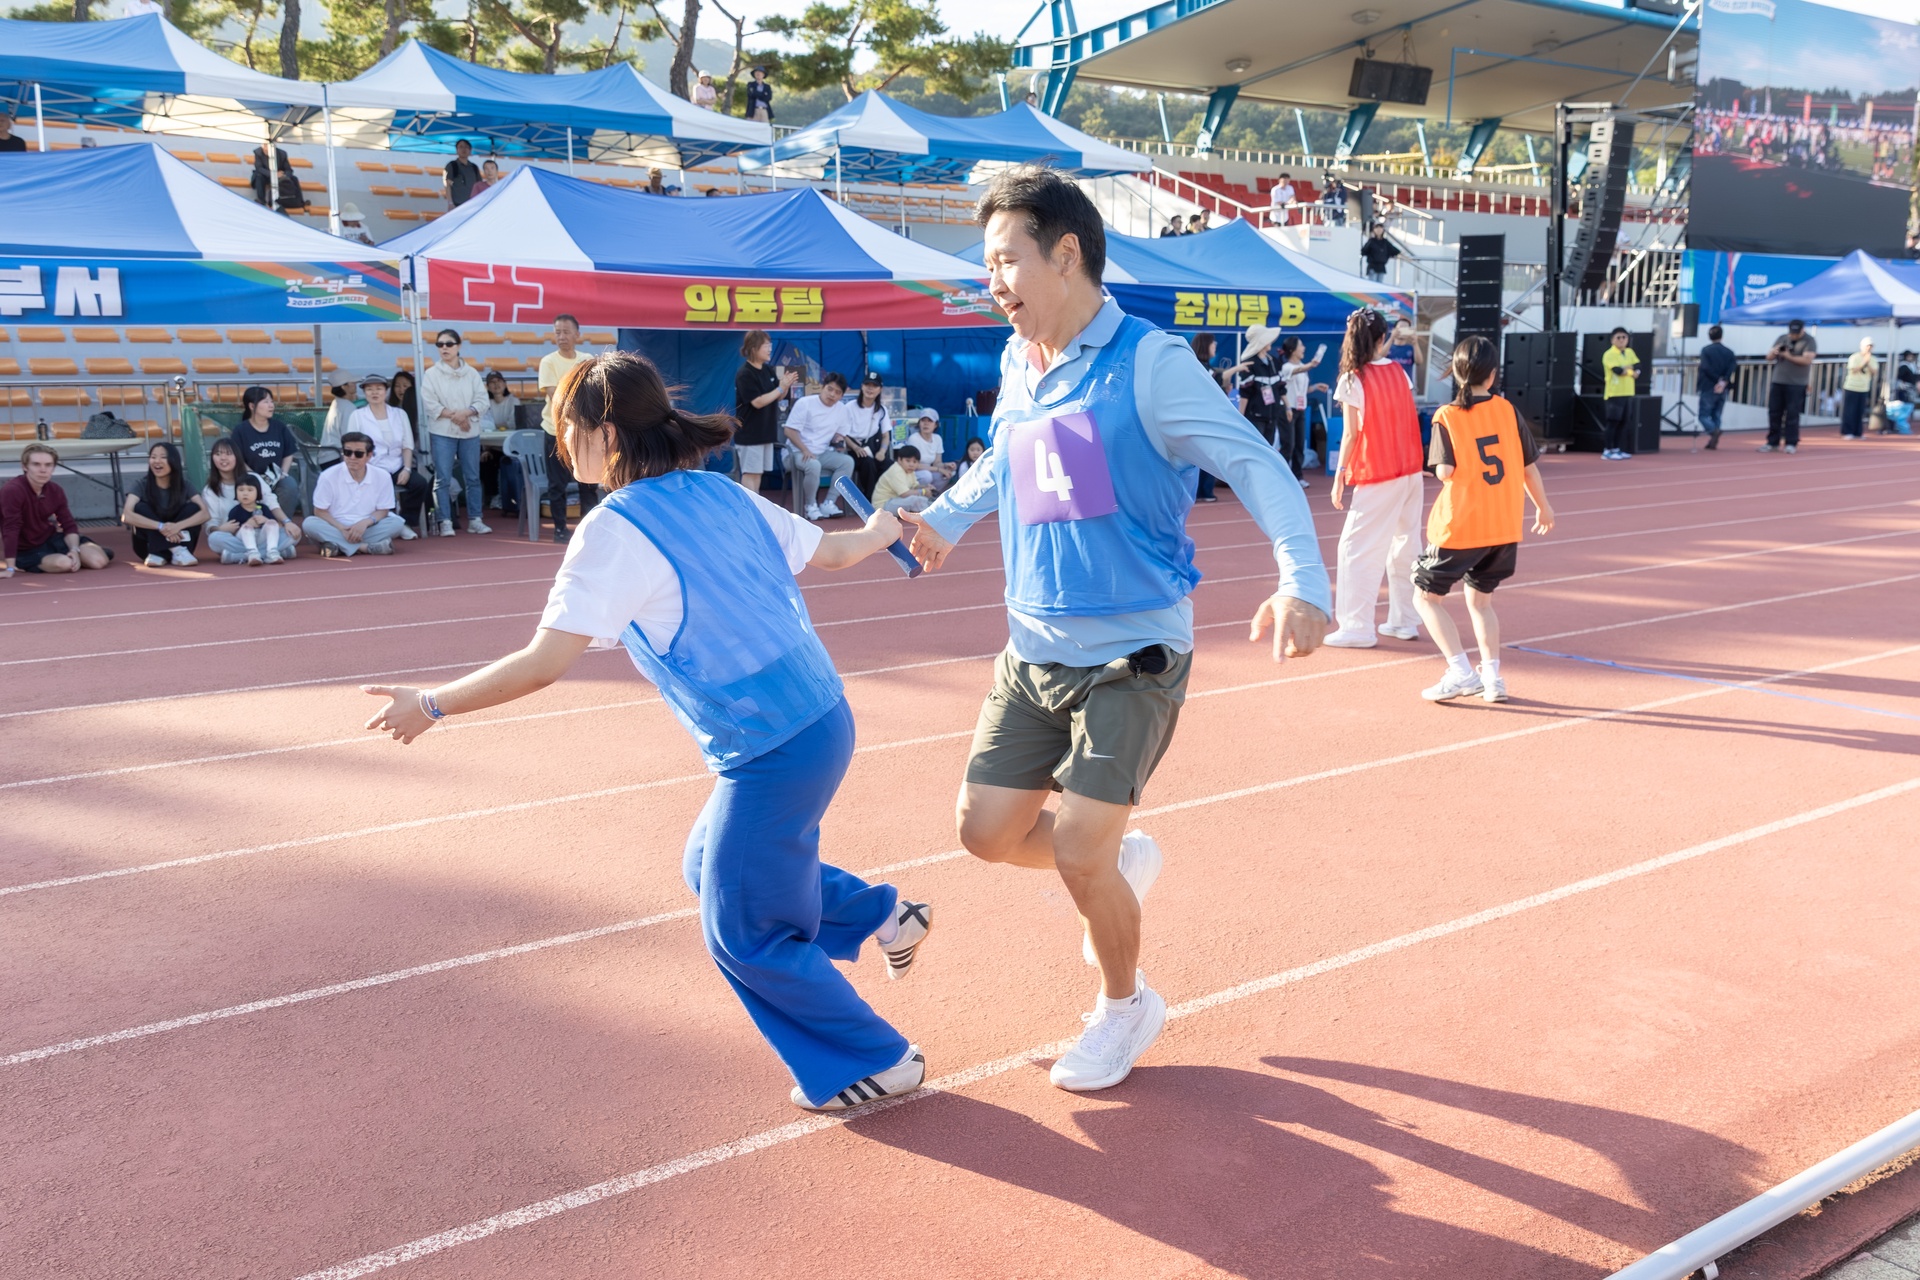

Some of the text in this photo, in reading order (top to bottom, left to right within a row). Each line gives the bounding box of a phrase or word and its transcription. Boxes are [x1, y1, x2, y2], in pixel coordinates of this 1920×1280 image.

[684, 284, 824, 323] 의료팀
[1173, 291, 1306, 327] 준비팀 B
[1034, 439, 1074, 501] 4
[1475, 434, 1505, 486] 5
